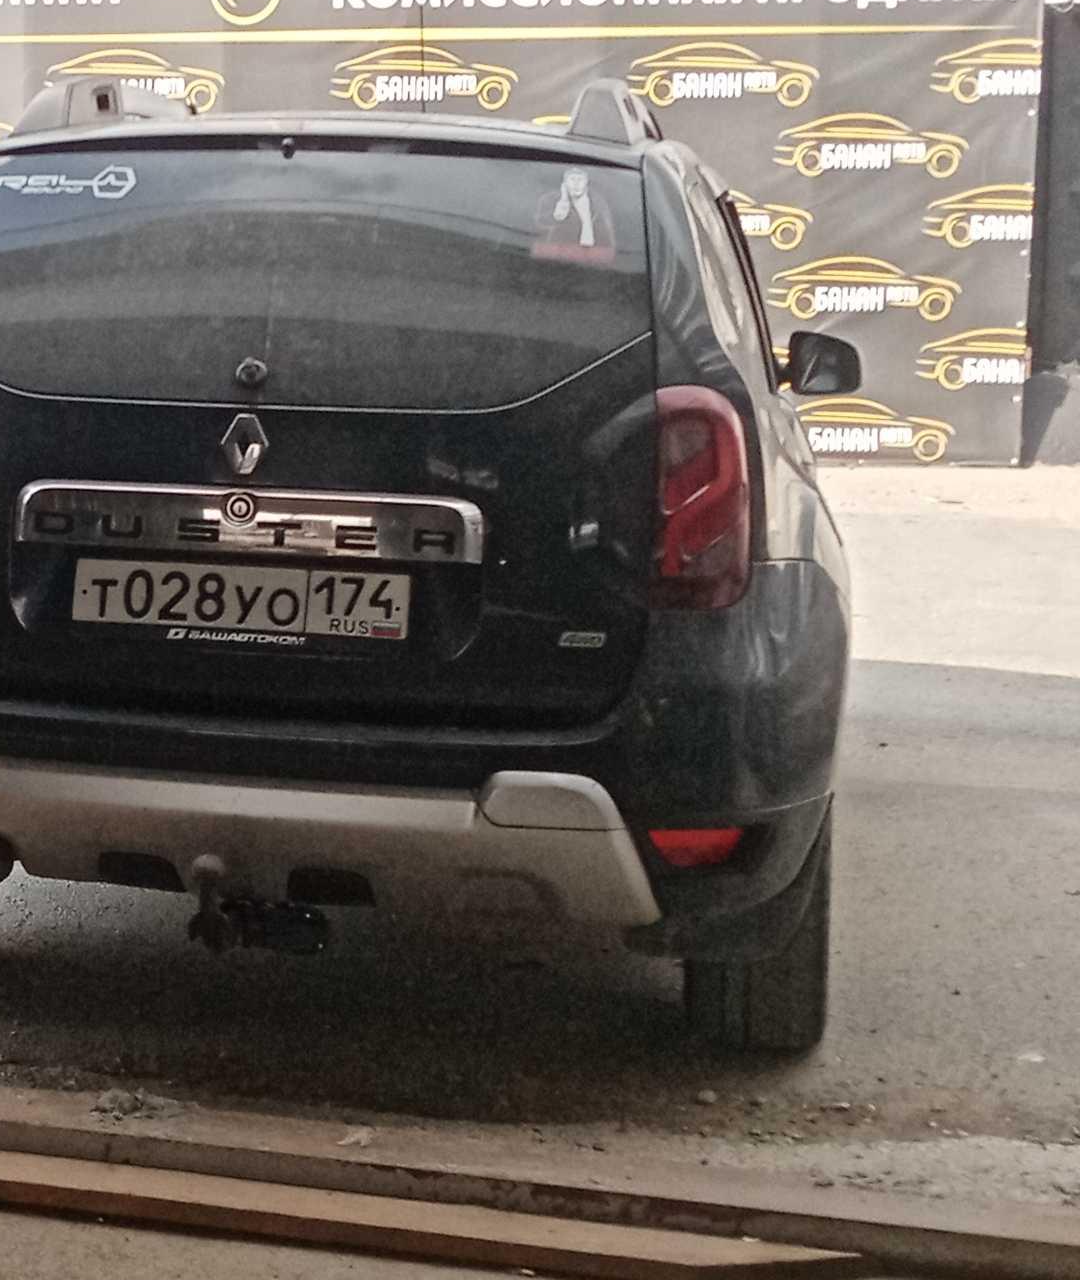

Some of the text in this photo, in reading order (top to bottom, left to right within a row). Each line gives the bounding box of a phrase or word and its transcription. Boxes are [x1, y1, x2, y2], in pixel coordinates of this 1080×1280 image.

[375, 71, 444, 102] БАНАН
[672, 71, 742, 98] БАНАН
[821, 142, 892, 169] БАНАН
[815, 285, 886, 312] БАНАН
[808, 427, 879, 452] БАНАН
[33, 511, 455, 554] DUSTER
[314, 576, 392, 618] 174
[328, 617, 369, 635] RUS
